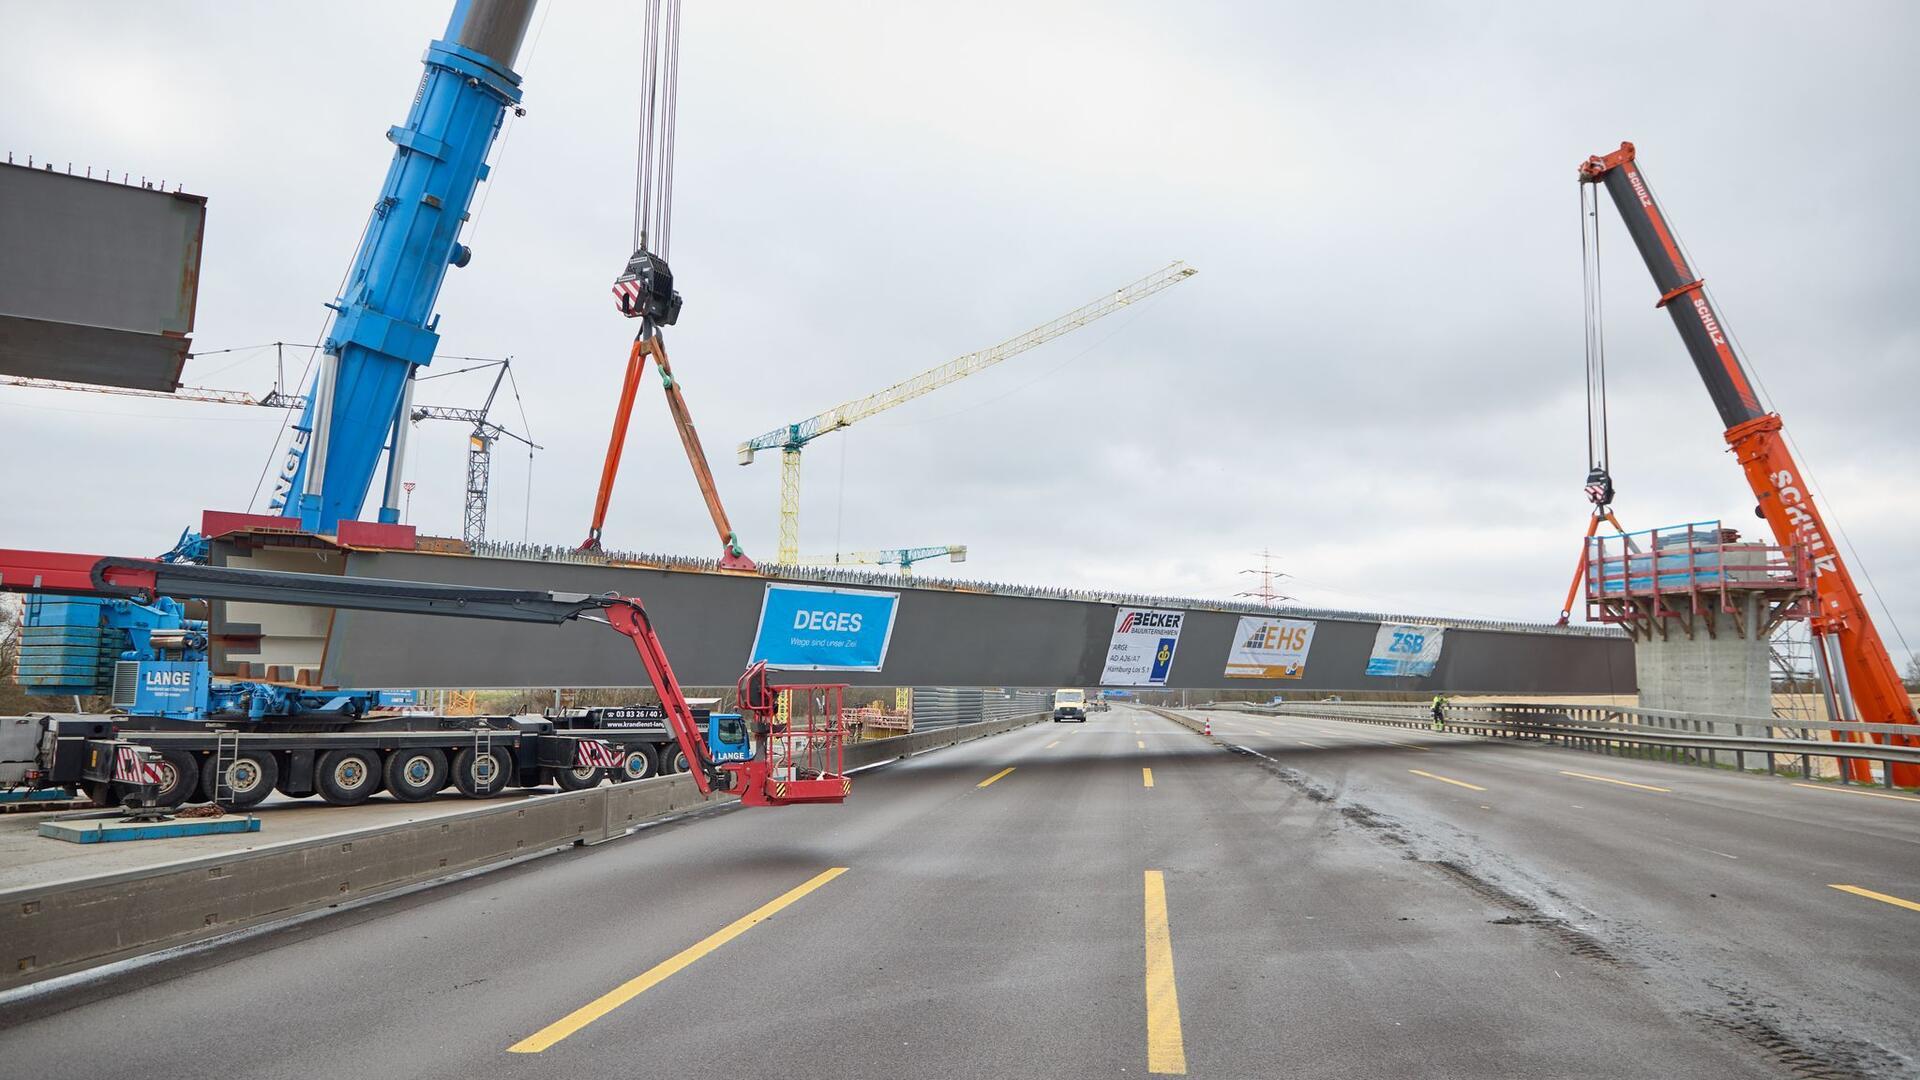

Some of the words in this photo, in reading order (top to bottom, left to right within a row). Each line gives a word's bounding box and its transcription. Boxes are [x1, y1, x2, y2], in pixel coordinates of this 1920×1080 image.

[1628, 172, 1652, 207] SCHULZ
[1694, 299, 1724, 346] SCHULZ
[793, 610, 863, 632] DEGES
[1133, 613, 1181, 628] BECKER
[790, 637, 810, 647] Wege
[811, 638, 825, 647] sind
[845, 639, 857, 648] Ziel
[1264, 626, 1307, 651] EHS
[1389, 632, 1425, 654] ZSB
[146, 671, 191, 686] LANGE
[1107, 666, 1132, 674] Hamburg
[718, 752, 745, 760] LANGE
